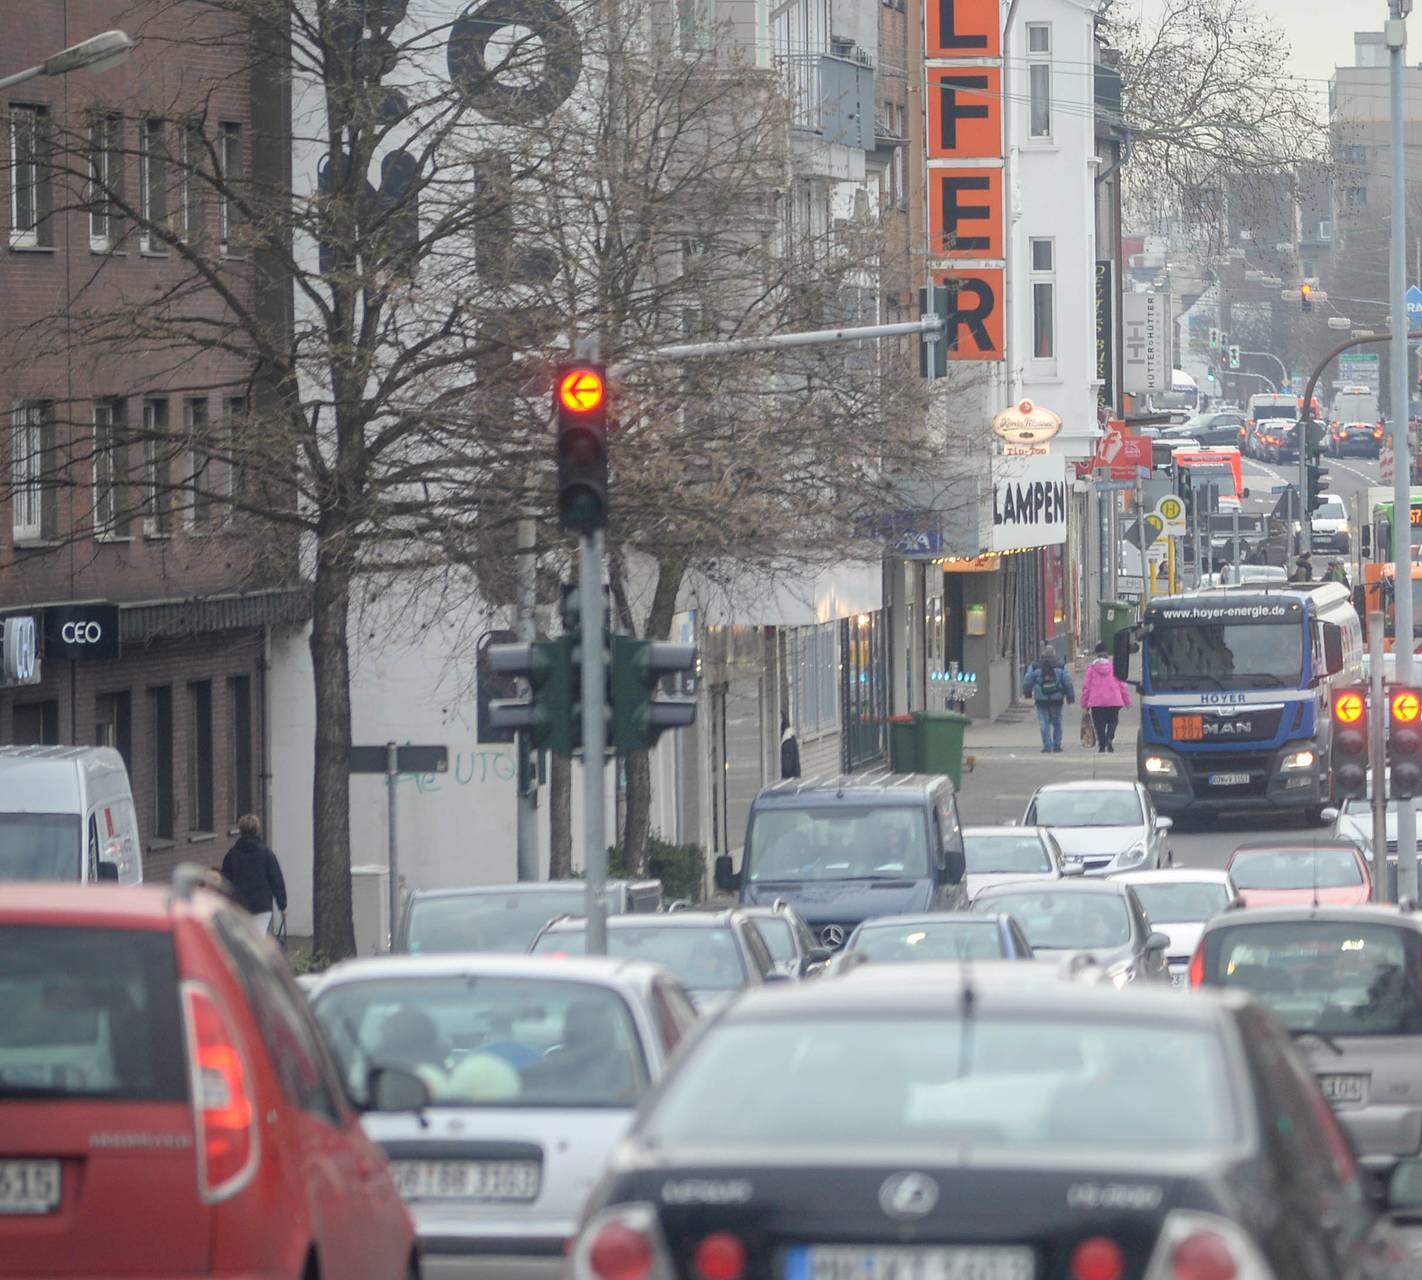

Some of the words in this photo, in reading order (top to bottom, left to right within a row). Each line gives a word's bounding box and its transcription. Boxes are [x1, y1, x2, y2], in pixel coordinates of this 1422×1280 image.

[993, 481, 1065, 525] LAMPEN
[1163, 604, 1286, 620] www.hoyer-energie.de
[62, 621, 101, 643] CEO
[1200, 693, 1247, 703] HOYER
[1204, 722, 1251, 735] MAN
